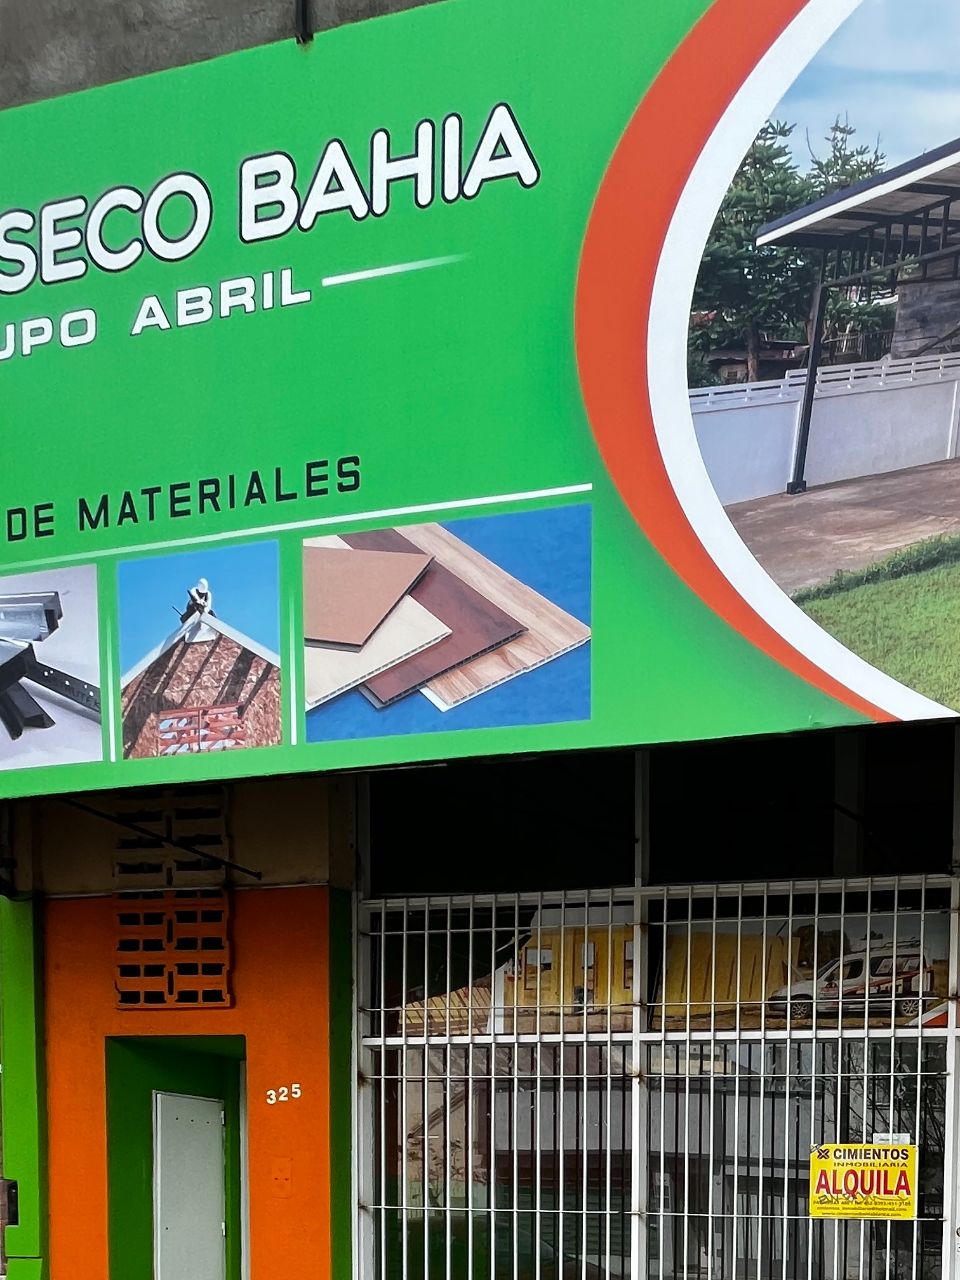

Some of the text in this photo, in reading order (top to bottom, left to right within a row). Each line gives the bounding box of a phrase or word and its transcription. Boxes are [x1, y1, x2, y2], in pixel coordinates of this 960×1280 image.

[0, 103, 540, 296] SECO BAHIA
[130, 267, 313, 336] ABRIL
[7, 455, 362, 542] DE MATERIALES
[266, 1083, 302, 1105] 325
[833, 1148, 909, 1161] CIMIENTOS
[815, 1169, 911, 1198] ALQUILA
